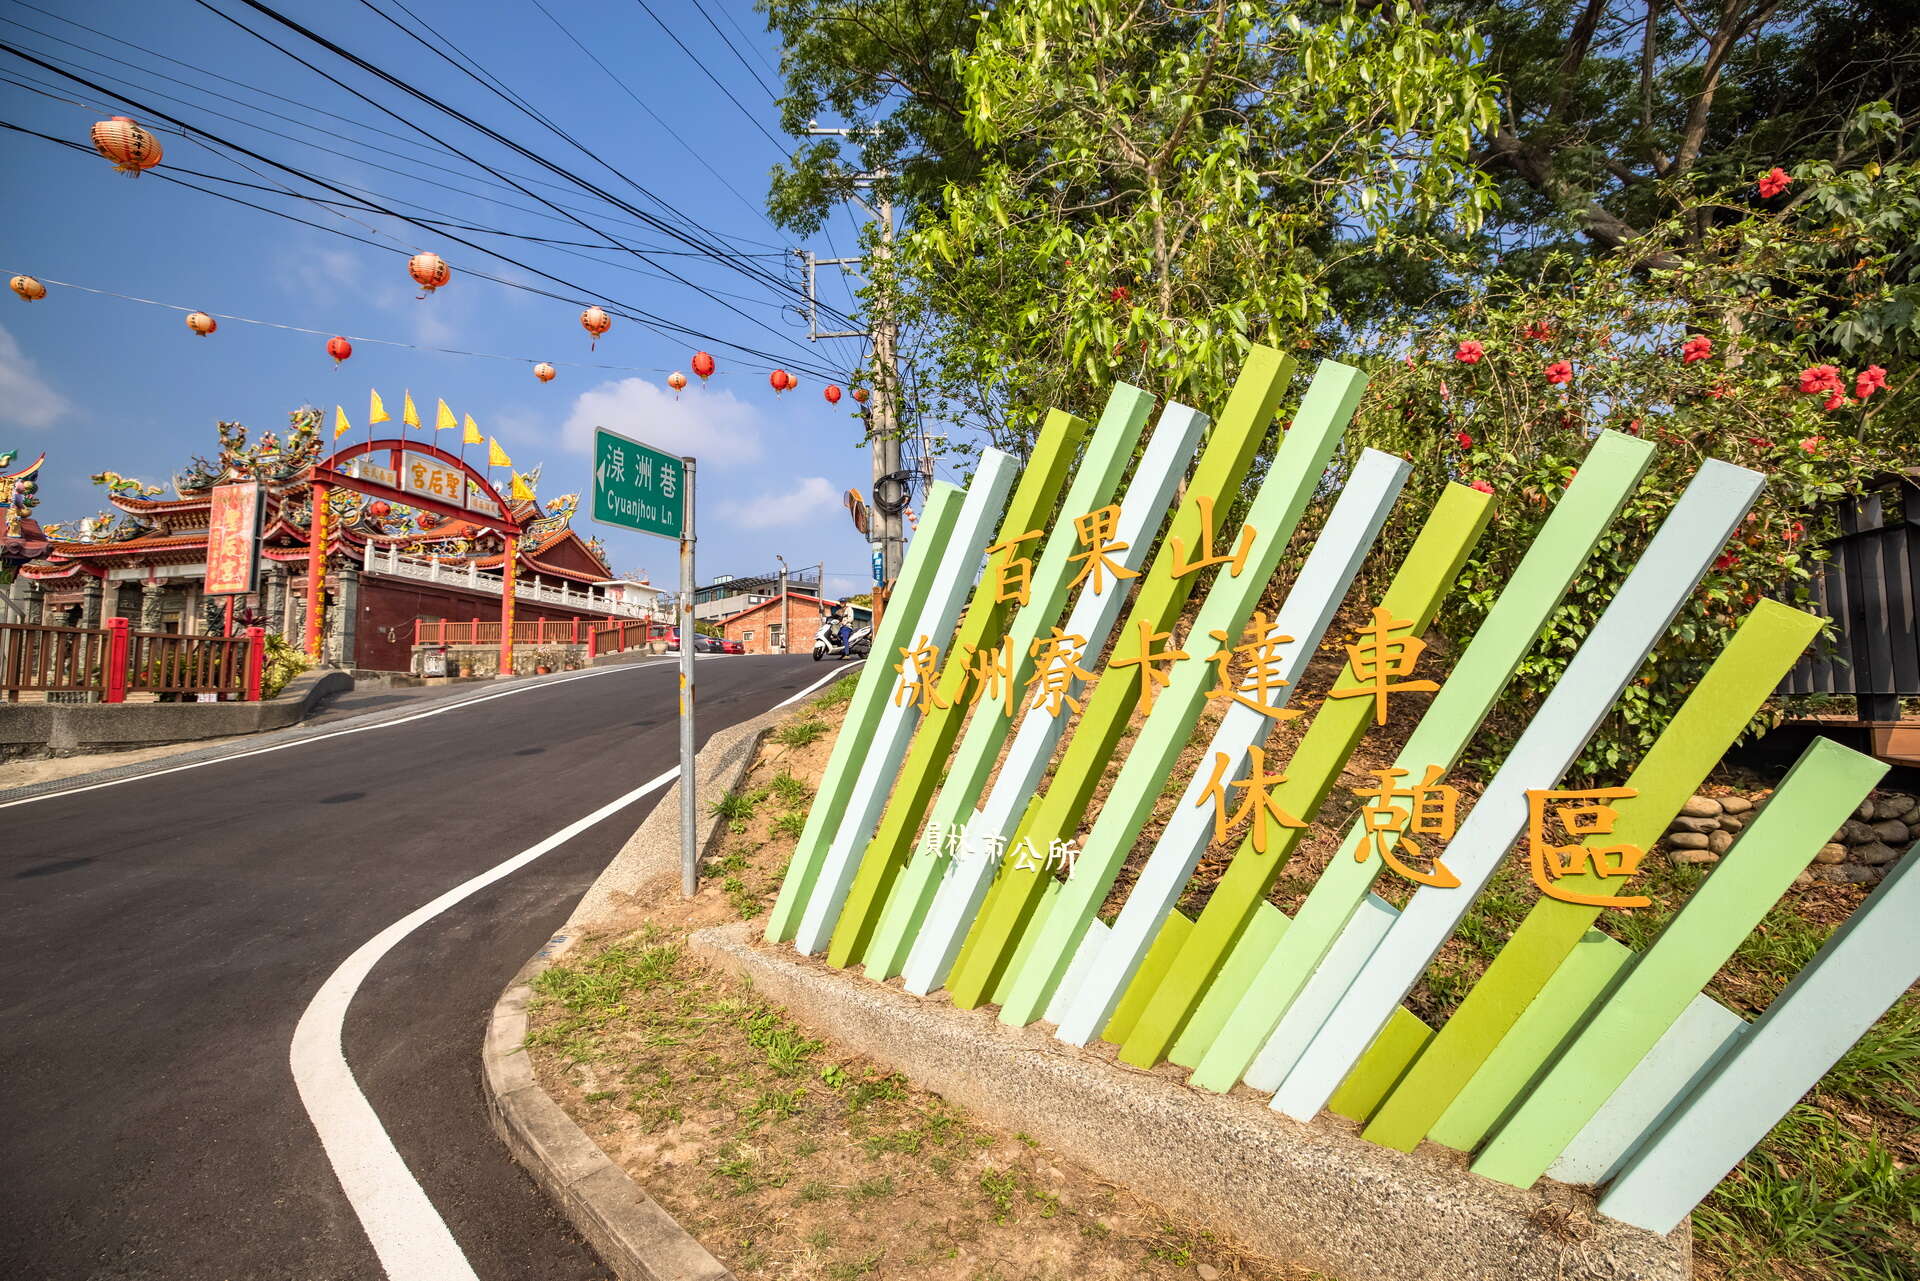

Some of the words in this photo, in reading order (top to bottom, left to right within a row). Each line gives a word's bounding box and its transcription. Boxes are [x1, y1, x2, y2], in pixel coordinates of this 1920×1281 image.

[606, 444, 677, 499] 湶洲巷
[607, 489, 656, 524] Cyuanjhou
[661, 505, 675, 526] Ln.
[984, 496, 1257, 607] 百果山
[893, 607, 1441, 726] 湶洲寮卡達車
[923, 822, 1083, 881] 員林市公所
[1196, 745, 1652, 909] 休憩區
